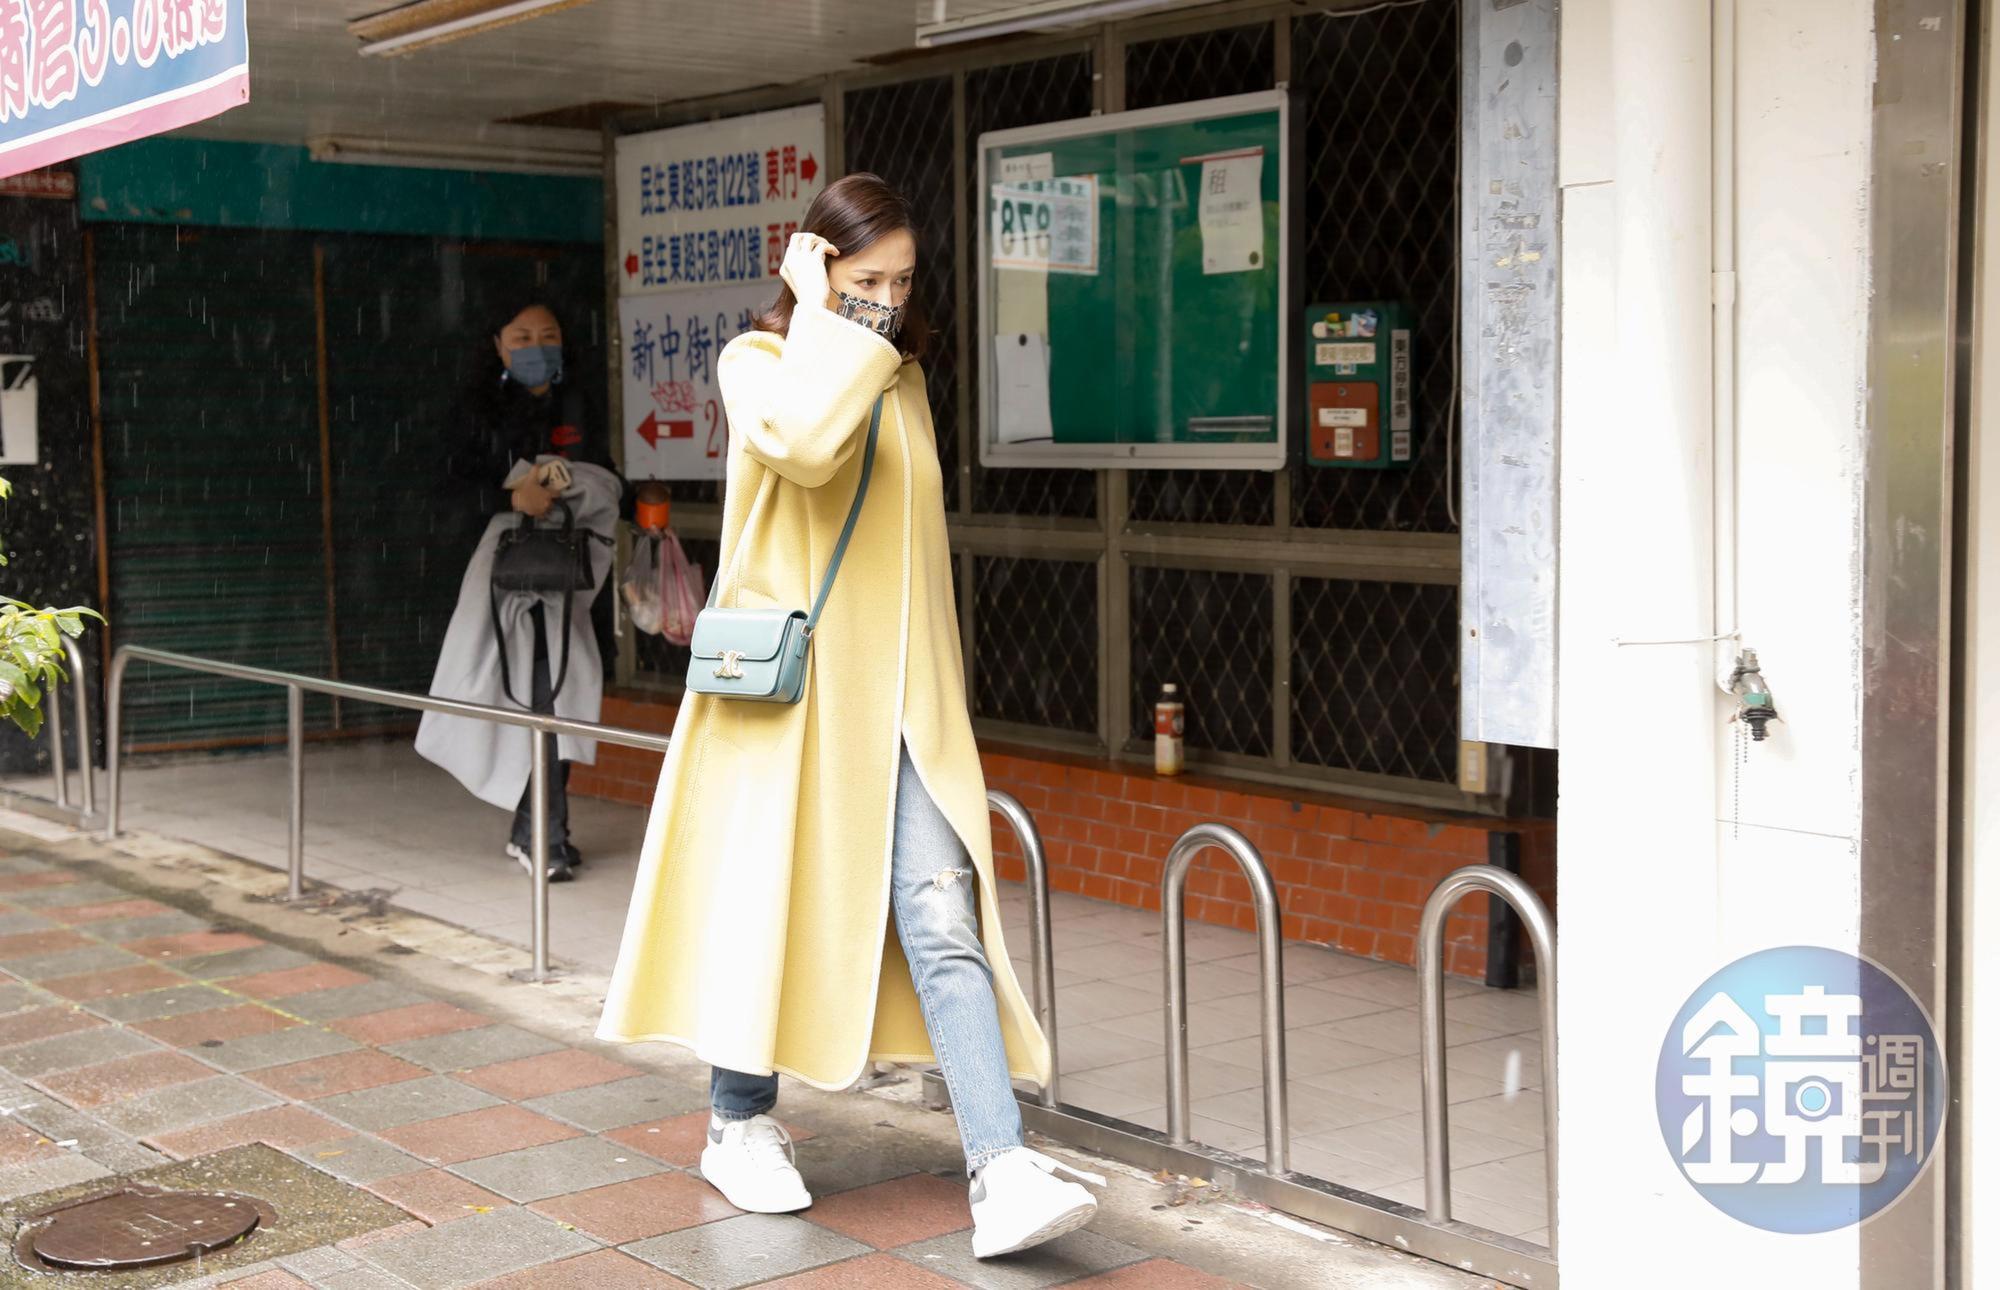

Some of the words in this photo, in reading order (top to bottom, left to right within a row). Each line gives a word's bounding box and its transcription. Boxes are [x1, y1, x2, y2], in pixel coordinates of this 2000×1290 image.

[640, 150, 761, 216] 民生東路5段122號
[764, 145, 798, 200] 東門
[641, 225, 762, 286] 民生東路5段120號
[705, 400, 730, 458] 2
